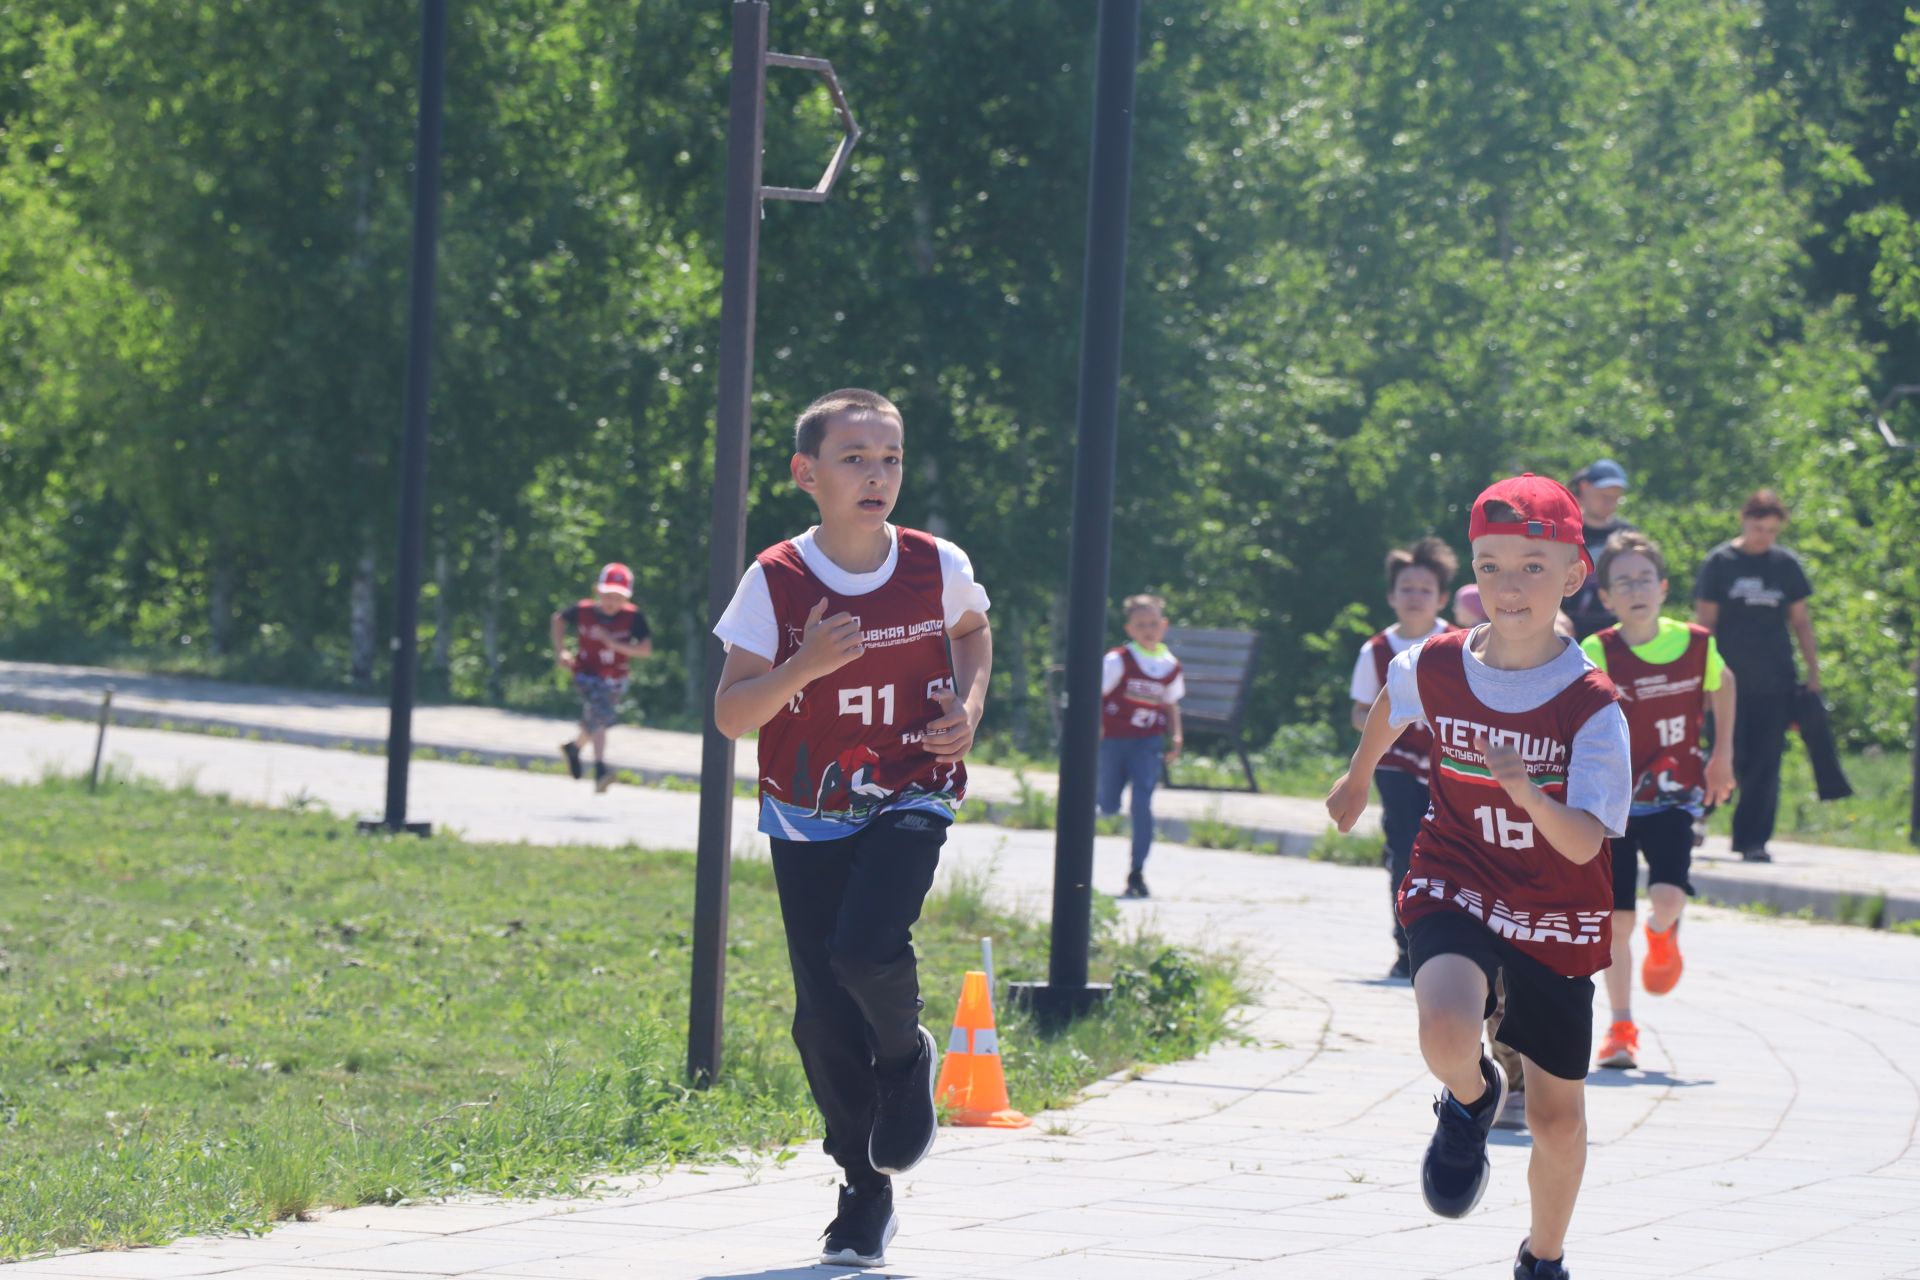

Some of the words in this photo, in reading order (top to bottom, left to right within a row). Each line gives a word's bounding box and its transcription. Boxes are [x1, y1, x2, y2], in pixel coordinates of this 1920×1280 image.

[861, 626, 905, 642] ИВНАЯ
[839, 684, 895, 725] 91
[1655, 715, 1686, 747] 18
[1441, 746, 1487, 764] РЕСПУБЛИ
[1474, 806, 1534, 850] 16
